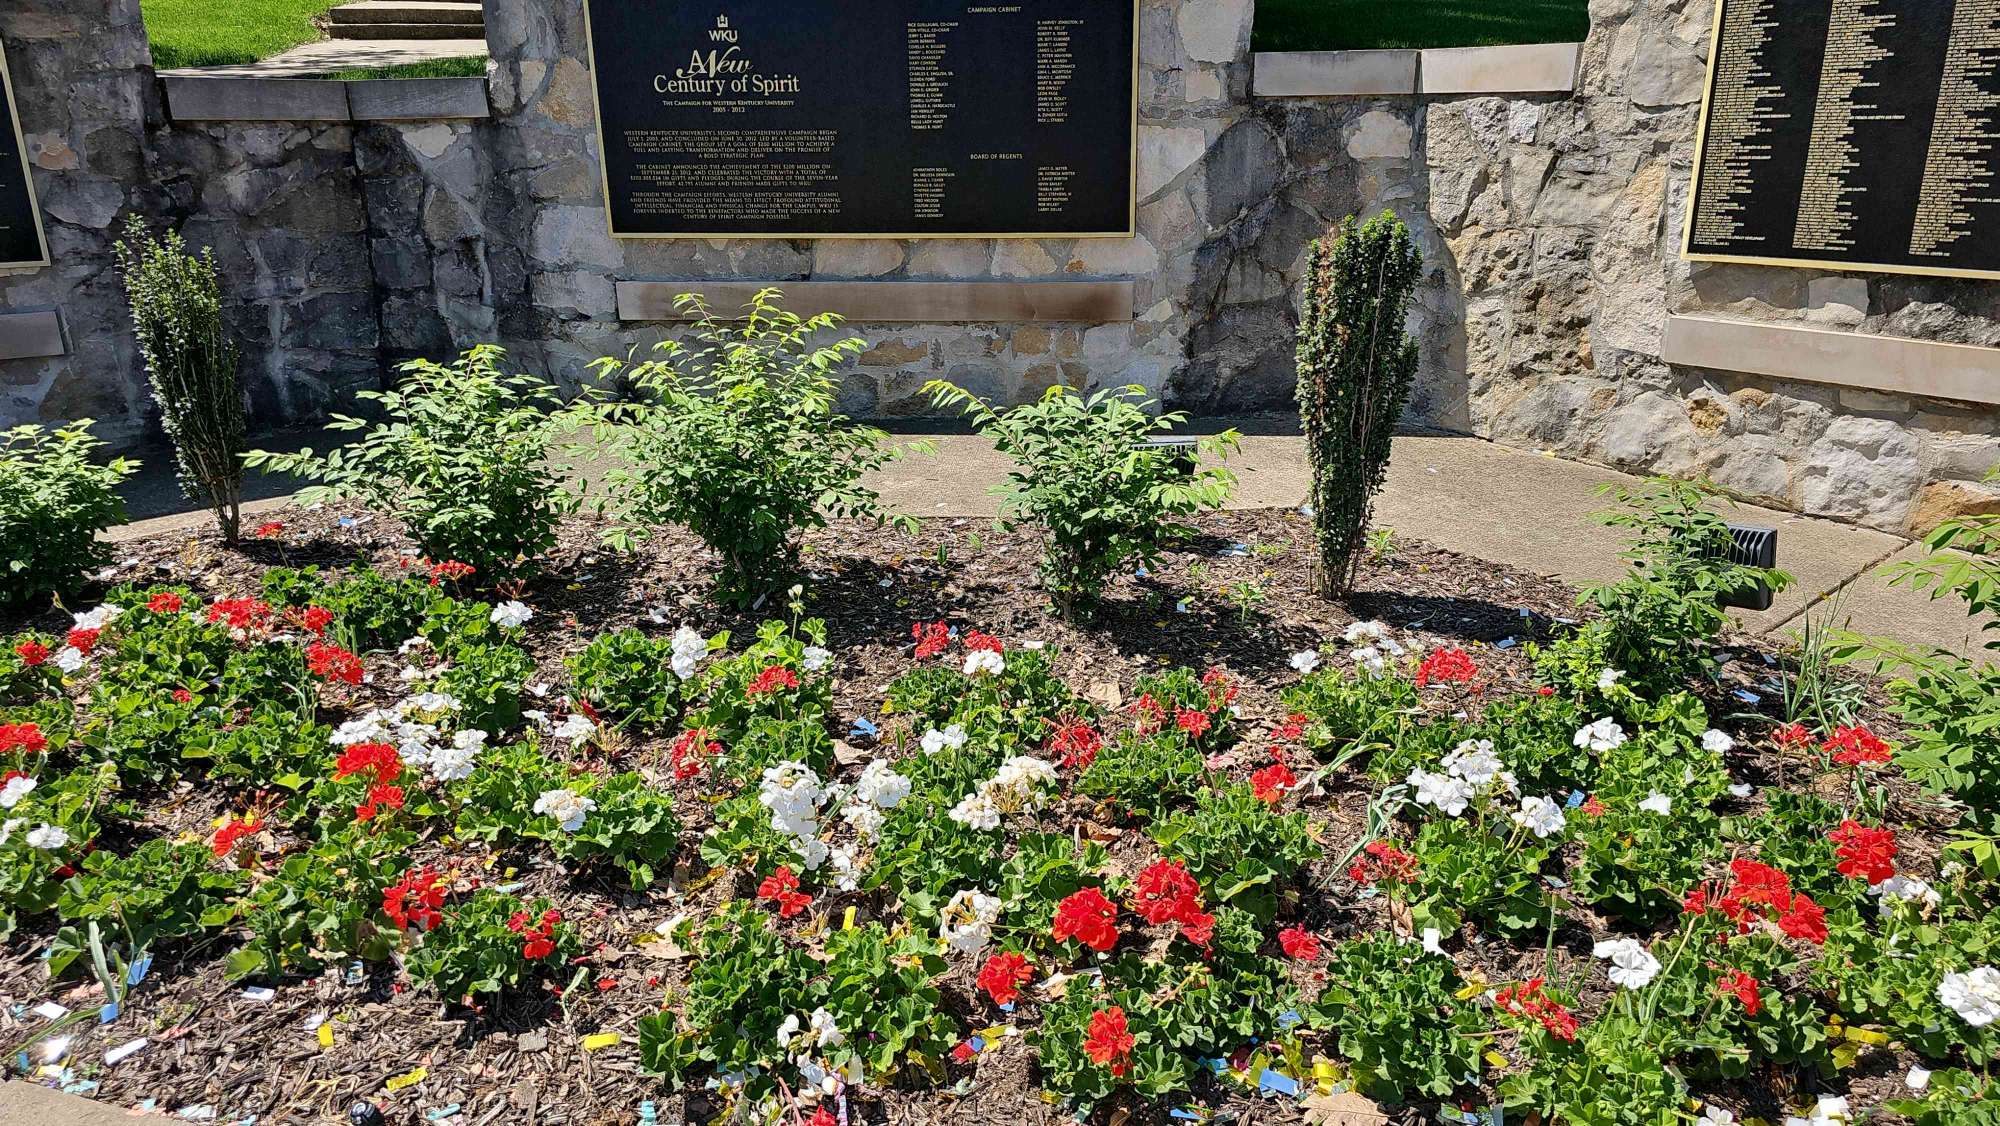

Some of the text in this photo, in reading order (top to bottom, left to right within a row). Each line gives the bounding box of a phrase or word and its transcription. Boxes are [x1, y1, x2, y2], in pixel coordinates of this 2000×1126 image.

[707, 29, 738, 43] WKU
[676, 45, 754, 79] A New
[653, 73, 801, 97] Century of Spirit
